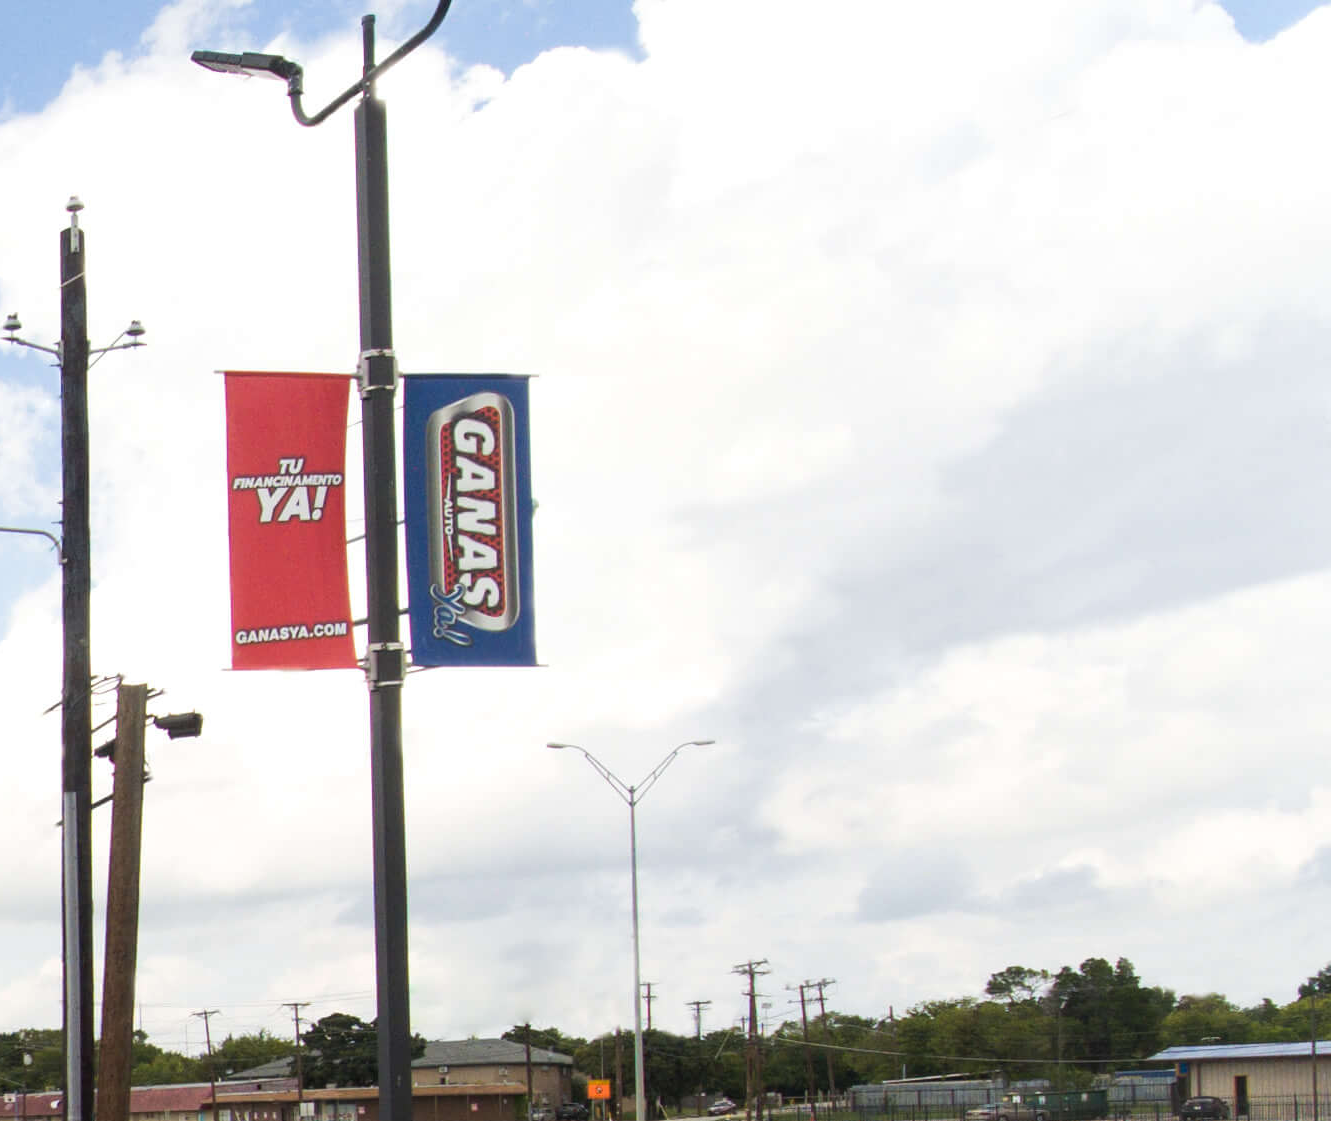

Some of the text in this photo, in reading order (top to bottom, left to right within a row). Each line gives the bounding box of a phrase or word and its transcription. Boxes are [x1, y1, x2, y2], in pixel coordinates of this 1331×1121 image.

[278, 458, 304, 475] TU
[257, 486, 327, 523] YA!
[444, 499, 455, 536] AUTO
[452, 419, 500, 609] GANAS
[430, 583, 473, 647] Ya!
[236, 622, 347, 646] GANASYA.COM
